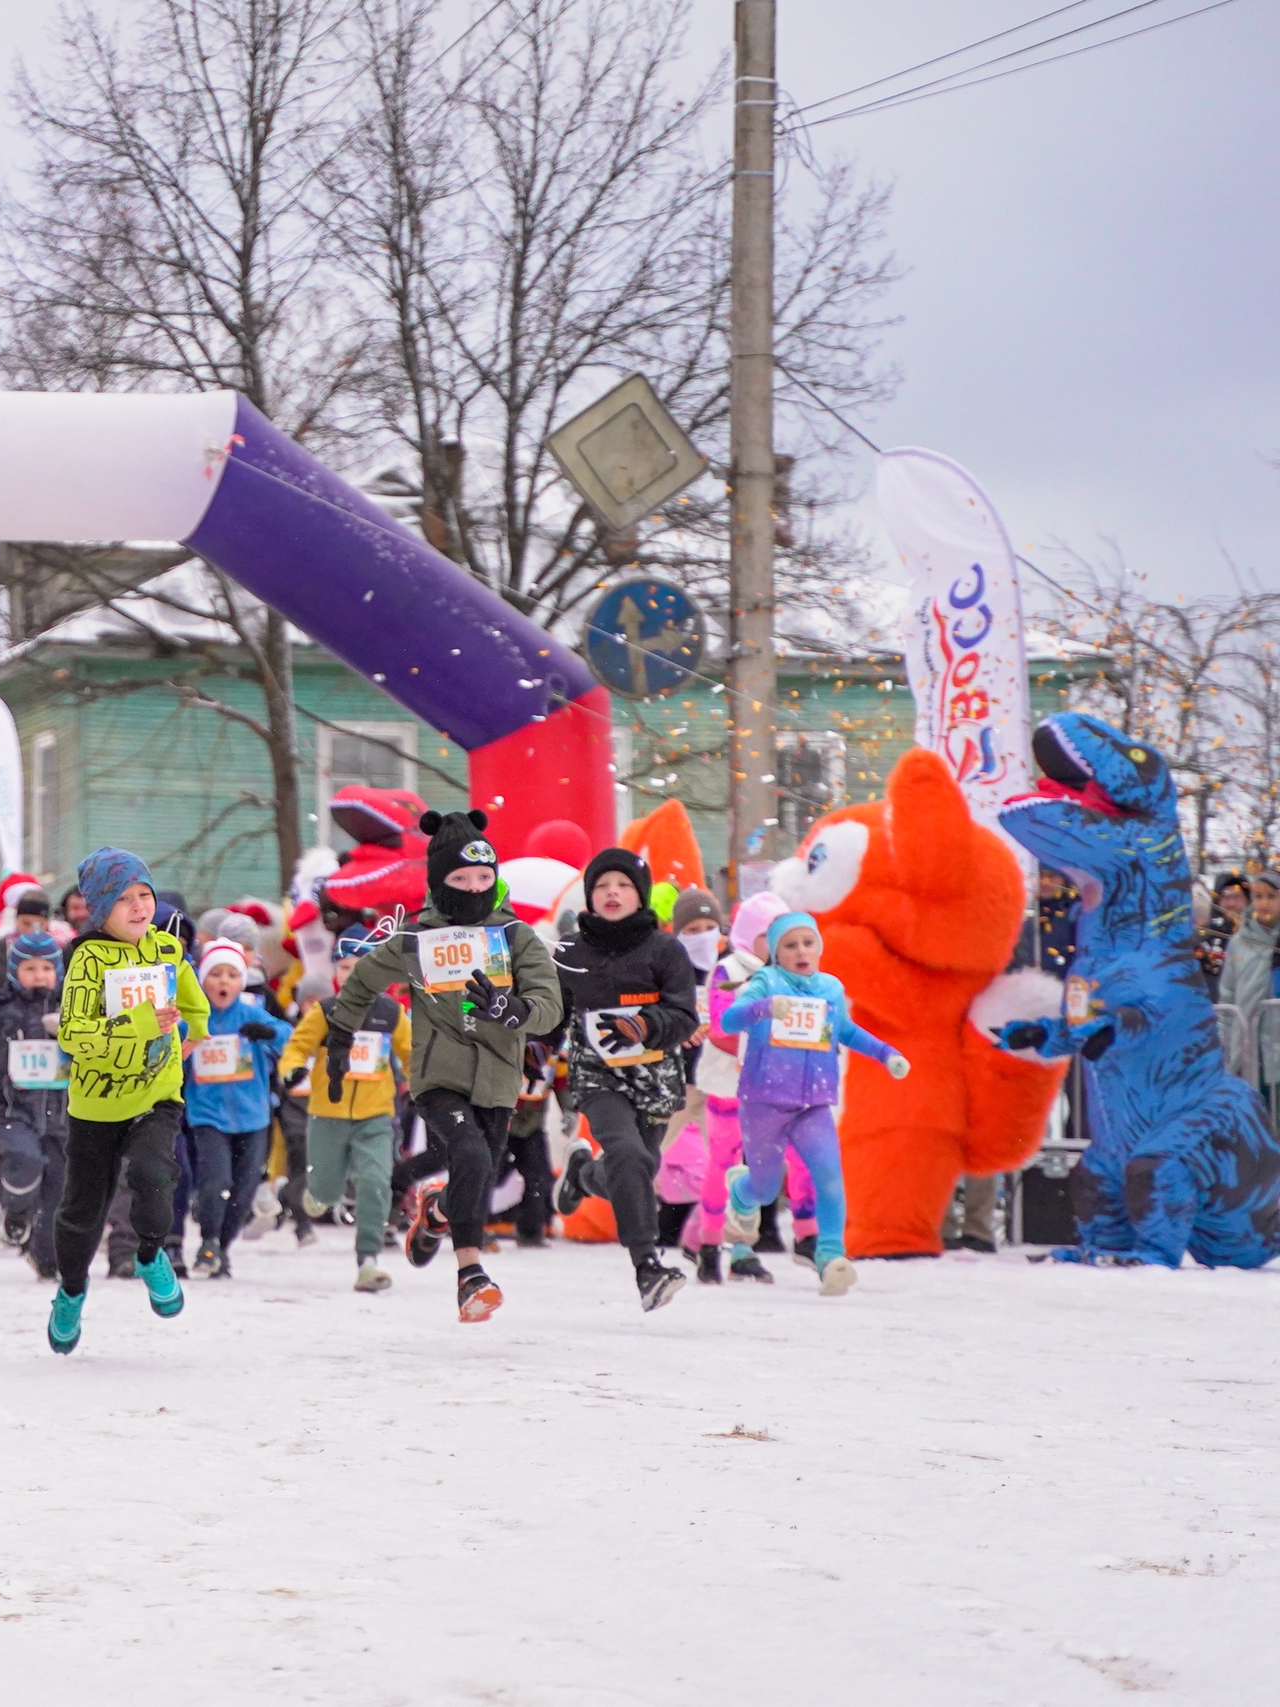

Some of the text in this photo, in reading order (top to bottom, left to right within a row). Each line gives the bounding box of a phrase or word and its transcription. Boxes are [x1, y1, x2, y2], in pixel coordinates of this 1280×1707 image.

[453, 931, 467, 940] 500
[433, 943, 473, 967] 509
[121, 985, 157, 1009] 516
[784, 1011, 815, 1029] 515
